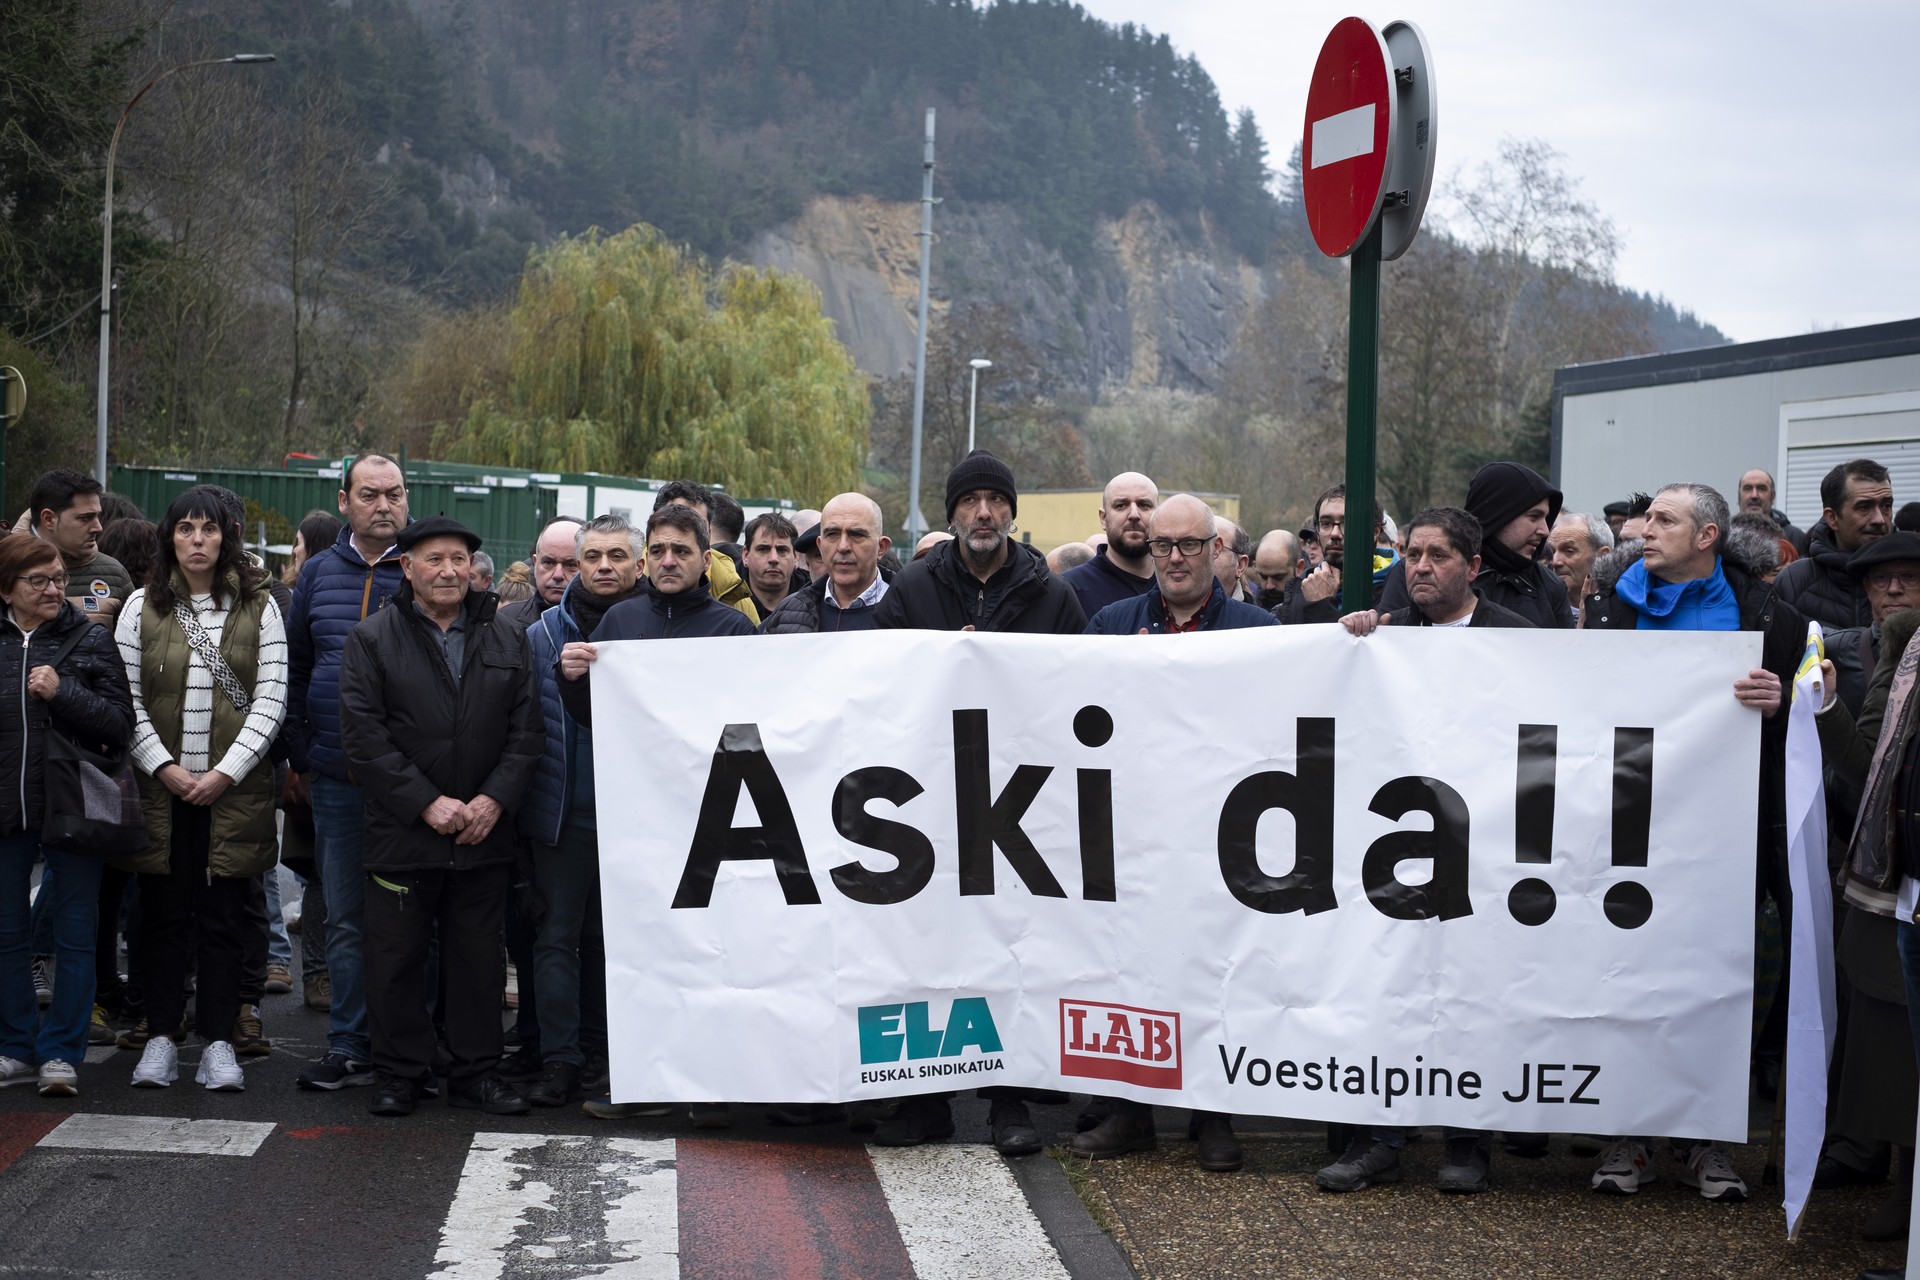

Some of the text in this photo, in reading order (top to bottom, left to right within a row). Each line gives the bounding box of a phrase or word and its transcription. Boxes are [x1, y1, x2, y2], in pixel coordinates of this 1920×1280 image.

[671, 705, 1654, 929] Aski da!!
[857, 997, 1004, 1065] ELA
[1068, 1008, 1172, 1062] LAB
[860, 1059, 1005, 1084] EUSKAL SINDIKATUA
[1219, 1045, 1601, 1109] Voestalpine JEZ
